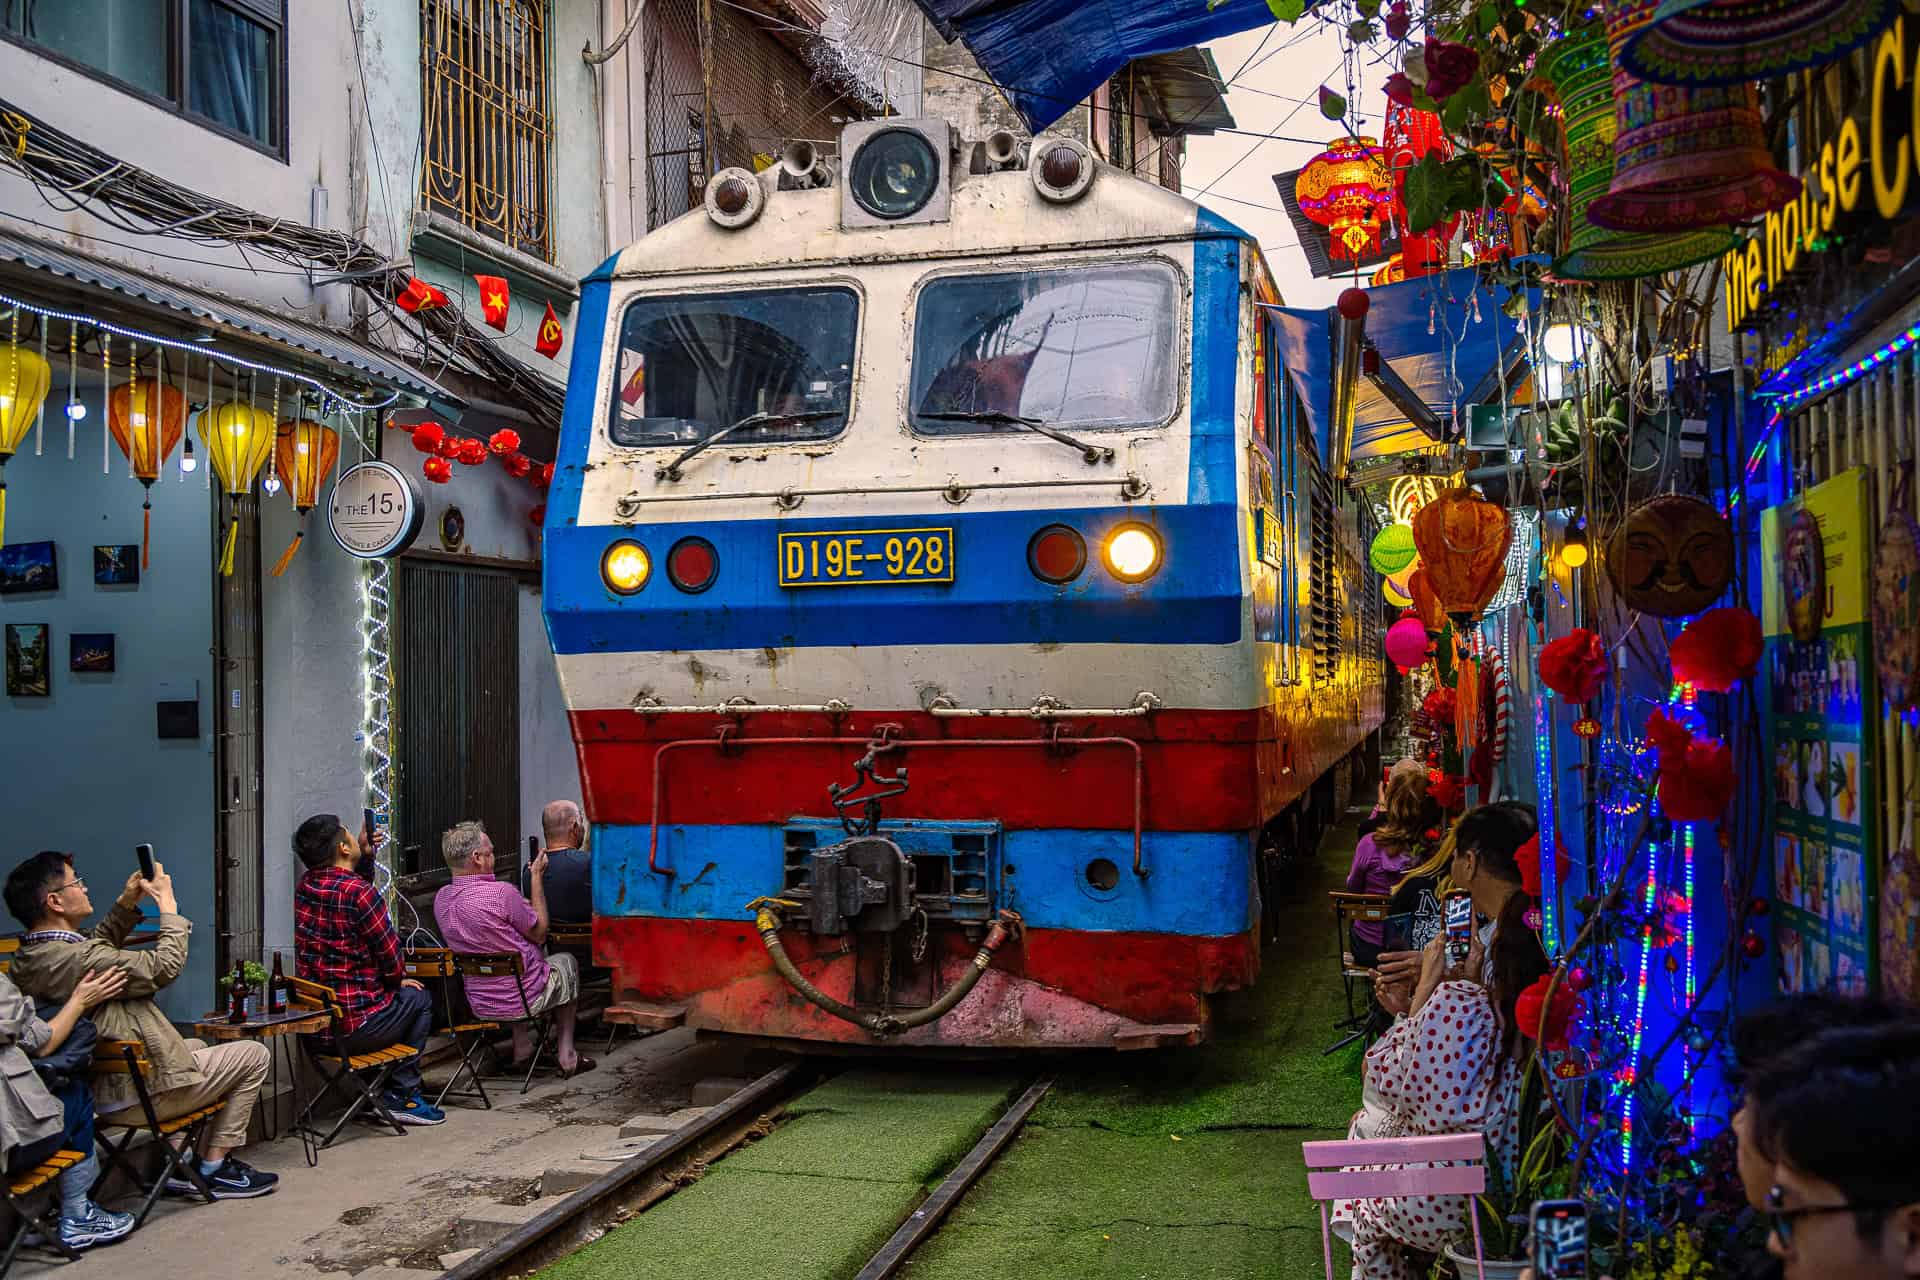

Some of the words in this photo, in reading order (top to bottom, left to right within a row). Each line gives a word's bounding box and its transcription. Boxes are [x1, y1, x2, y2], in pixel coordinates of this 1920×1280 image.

[344, 504, 368, 516] THE
[368, 492, 393, 515] 15
[786, 536, 944, 579] D19E-928
